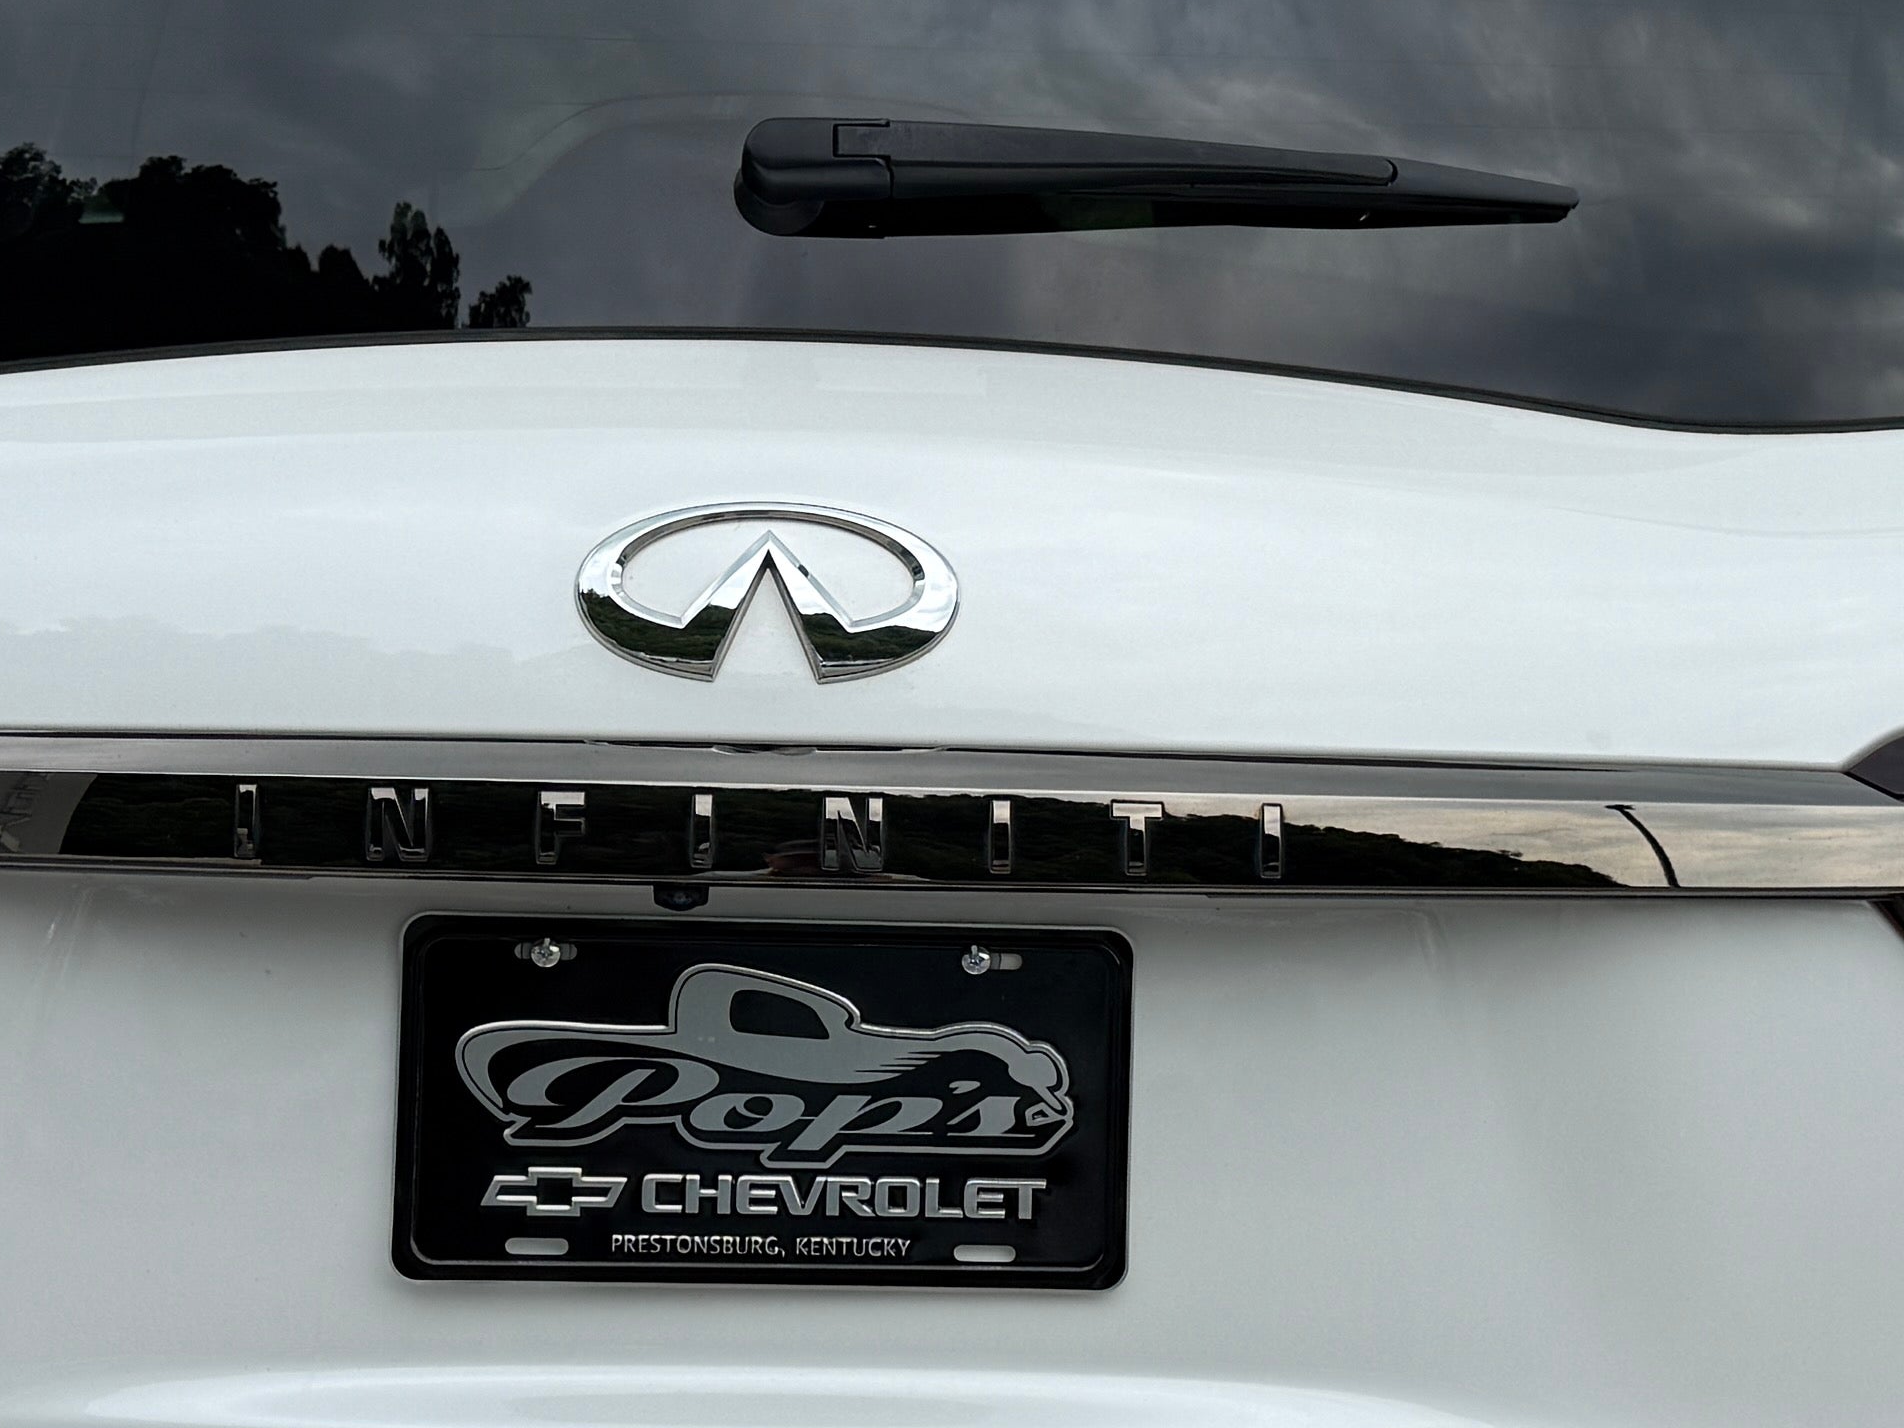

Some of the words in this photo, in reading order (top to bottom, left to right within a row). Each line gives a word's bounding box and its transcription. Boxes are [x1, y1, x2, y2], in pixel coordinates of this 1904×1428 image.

[233, 782, 1284, 878] INFINITI
[640, 1173, 1048, 1220] CHEVROLET
[610, 1233, 787, 1258] PRESTONSBURG,
[795, 1236, 912, 1258] KENTUCKY
